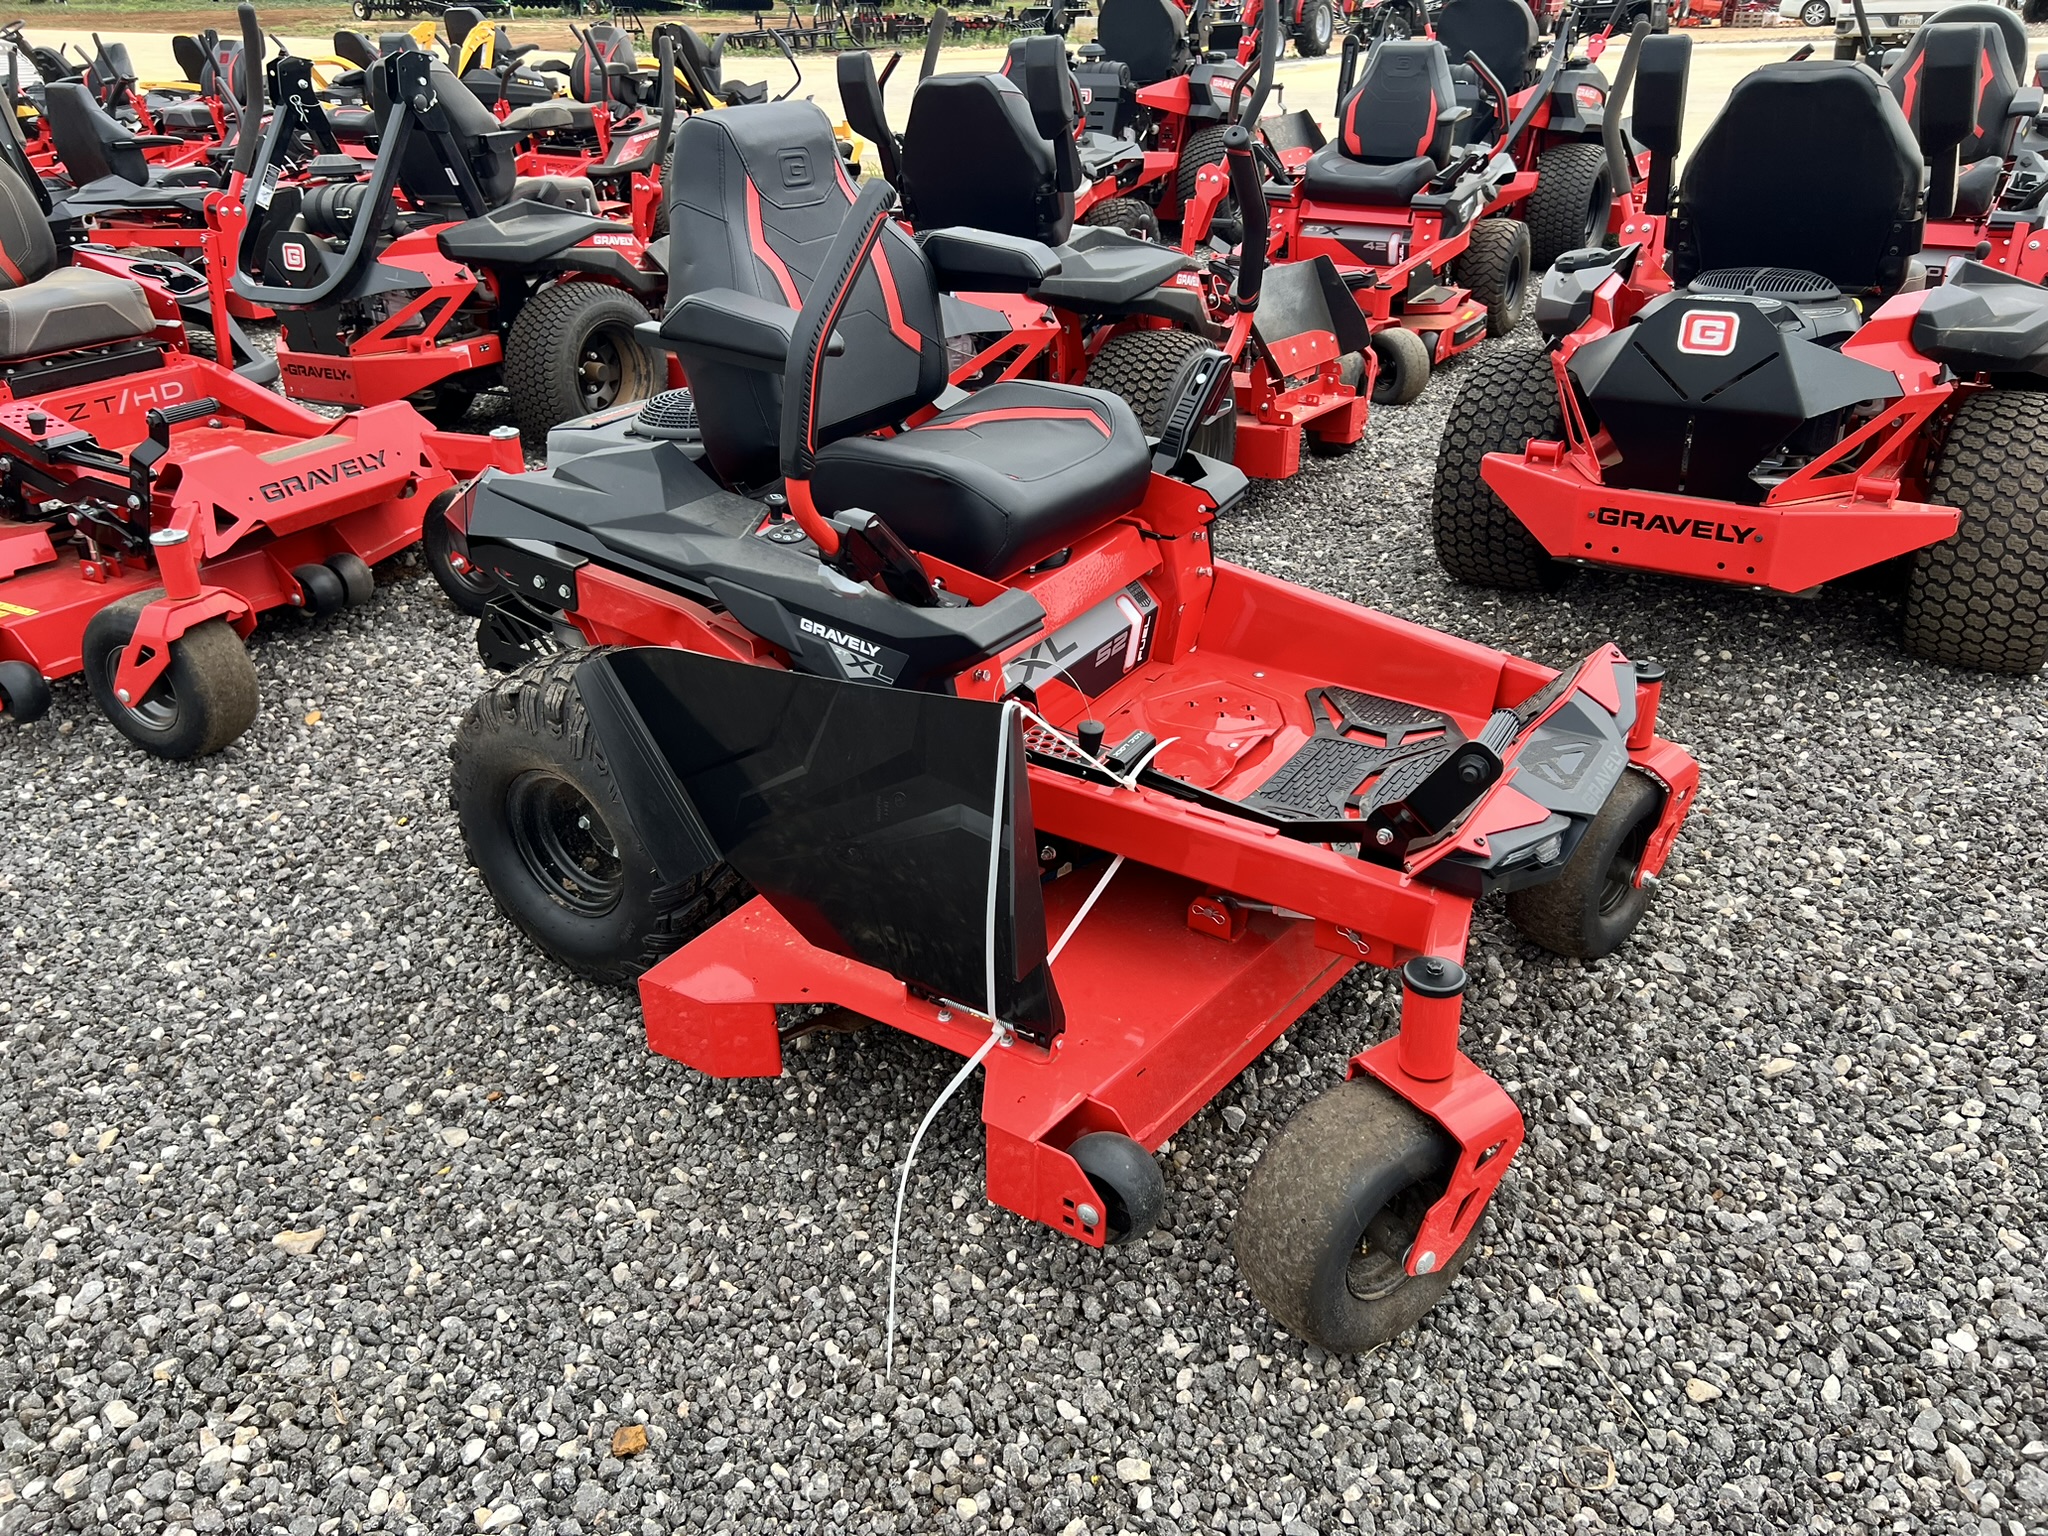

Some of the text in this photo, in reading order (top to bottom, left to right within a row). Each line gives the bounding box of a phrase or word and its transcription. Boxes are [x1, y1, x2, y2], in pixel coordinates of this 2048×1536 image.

[593, 235, 634, 246] GRAVELY
[1363, 241, 1386, 251] 42
[286, 363, 348, 381] GRAVELY
[64, 381, 184, 423] ZT/HD
[259, 449, 386, 503] GRAVELY
[1597, 506, 1757, 545] GRAVELY
[800, 617, 881, 658] GRAVELY
[1094, 630, 1129, 669] 52
[1137, 615, 1152, 662] FUEL
[845, 653, 895, 686] XL
[1010, 637, 1079, 685] XL
[1582, 745, 1626, 809] GRAVELY
